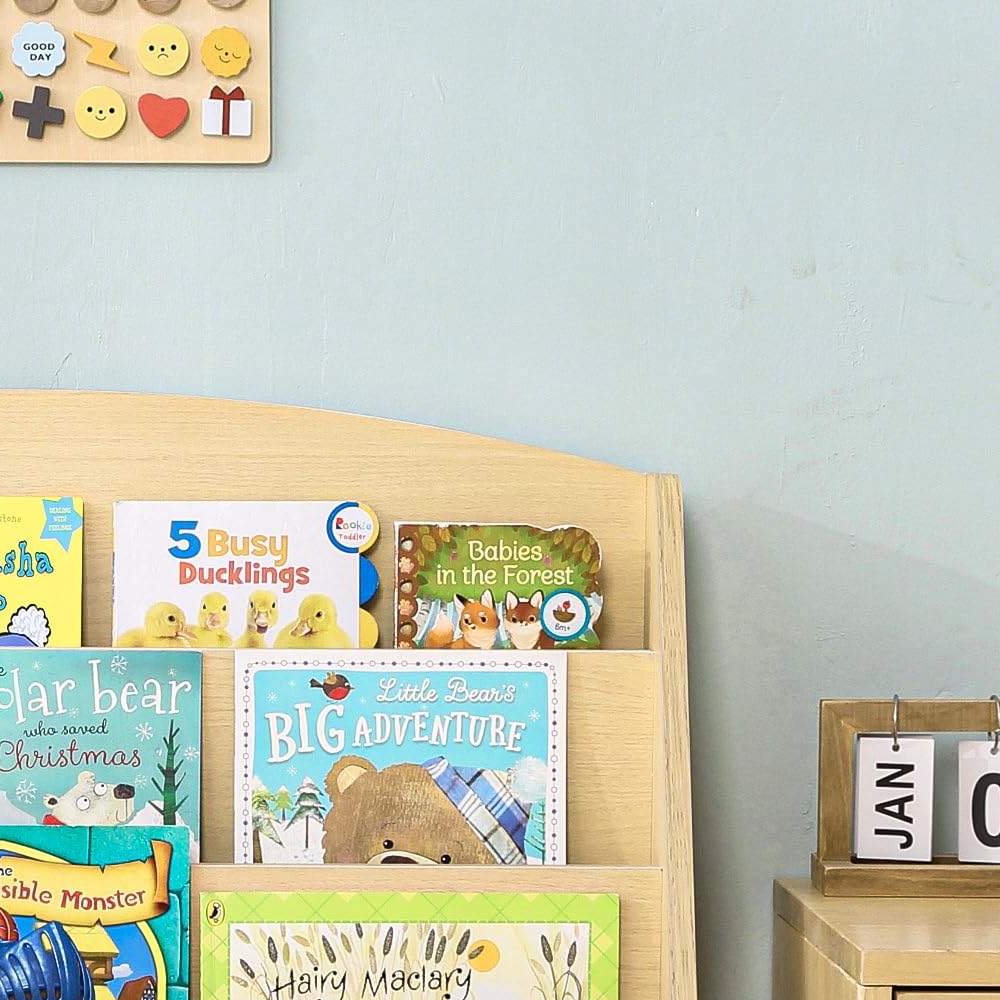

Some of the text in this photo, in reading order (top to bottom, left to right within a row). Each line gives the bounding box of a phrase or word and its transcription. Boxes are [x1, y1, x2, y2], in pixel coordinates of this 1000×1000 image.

[23, 42, 55, 51] GOOD
[29, 53, 51, 62] DAY
[167, 520, 289, 567] 5 Busy
[338, 533, 366, 541] Toddler
[468, 540, 543, 563] Babies
[179, 561, 310, 593] Ducklings
[436, 564, 575, 586] in the Forest
[88, 659, 193, 716] bear
[376, 677, 516, 703] Little Bear's
[23, 718, 109, 738] who saved
[264, 702, 527, 764] BIG ADVENTURE
[874, 762, 915, 850] JAN
[61, 889, 146, 911] Monster
